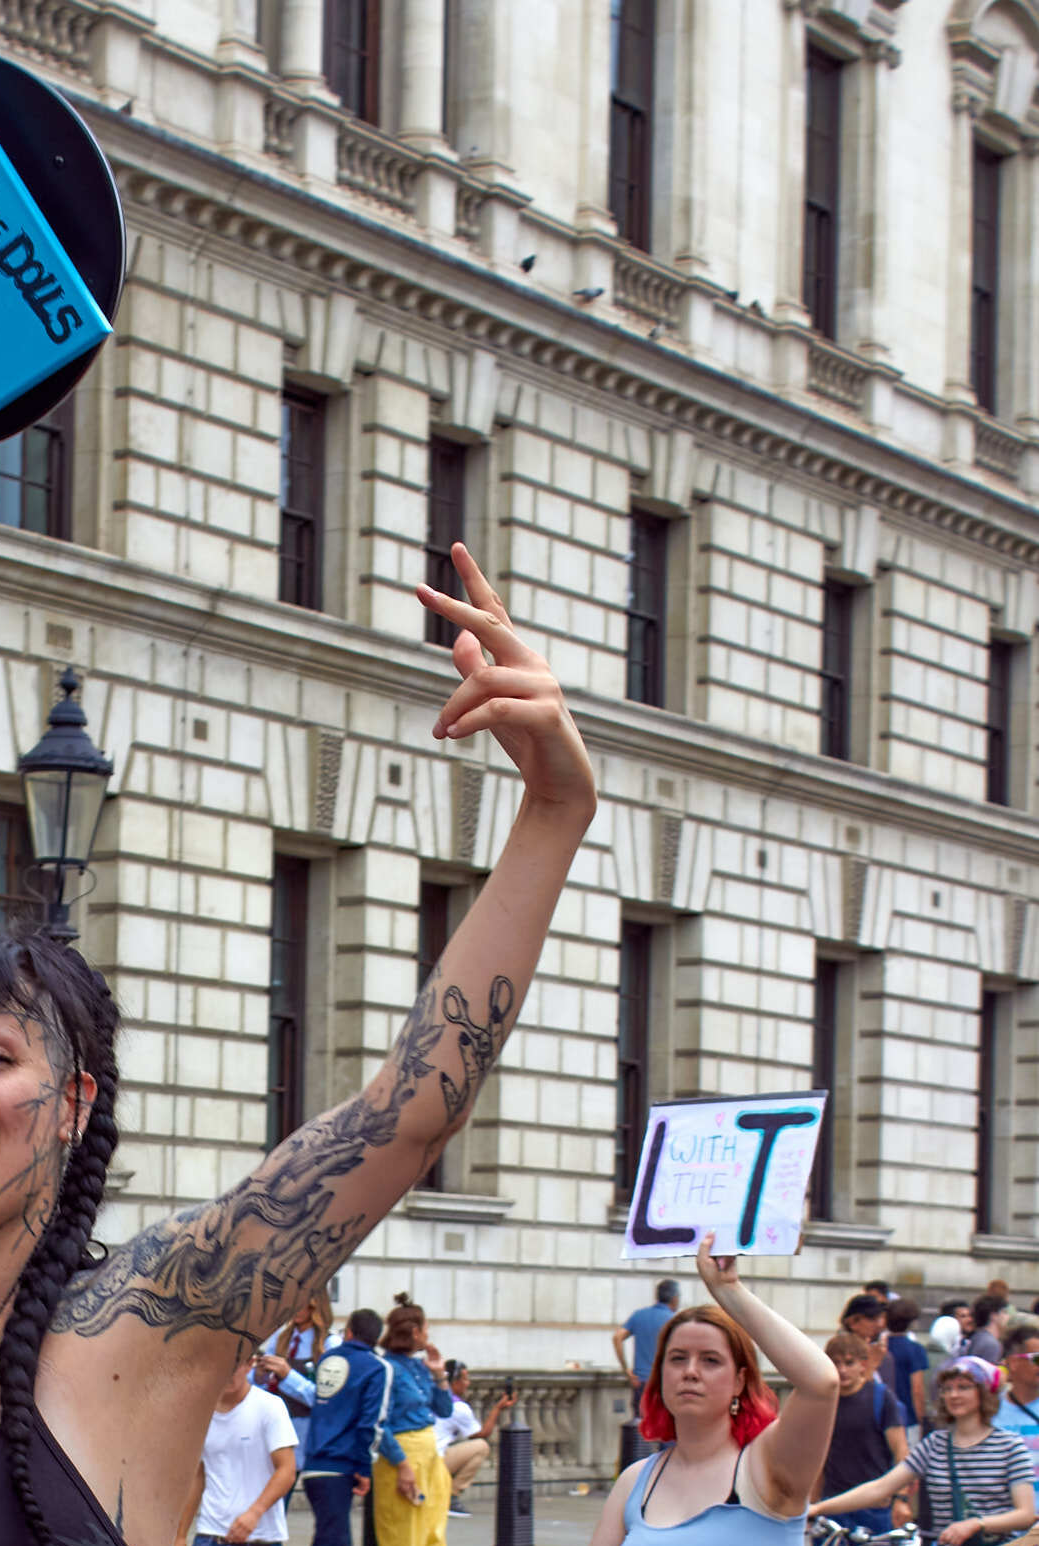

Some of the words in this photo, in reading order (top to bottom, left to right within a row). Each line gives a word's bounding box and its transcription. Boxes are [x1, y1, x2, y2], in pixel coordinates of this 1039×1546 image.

[631, 1118, 698, 1247] L
[670, 1135, 737, 1163] WITH
[673, 1172, 729, 1205] THE
[736, 1110, 818, 1247] T
